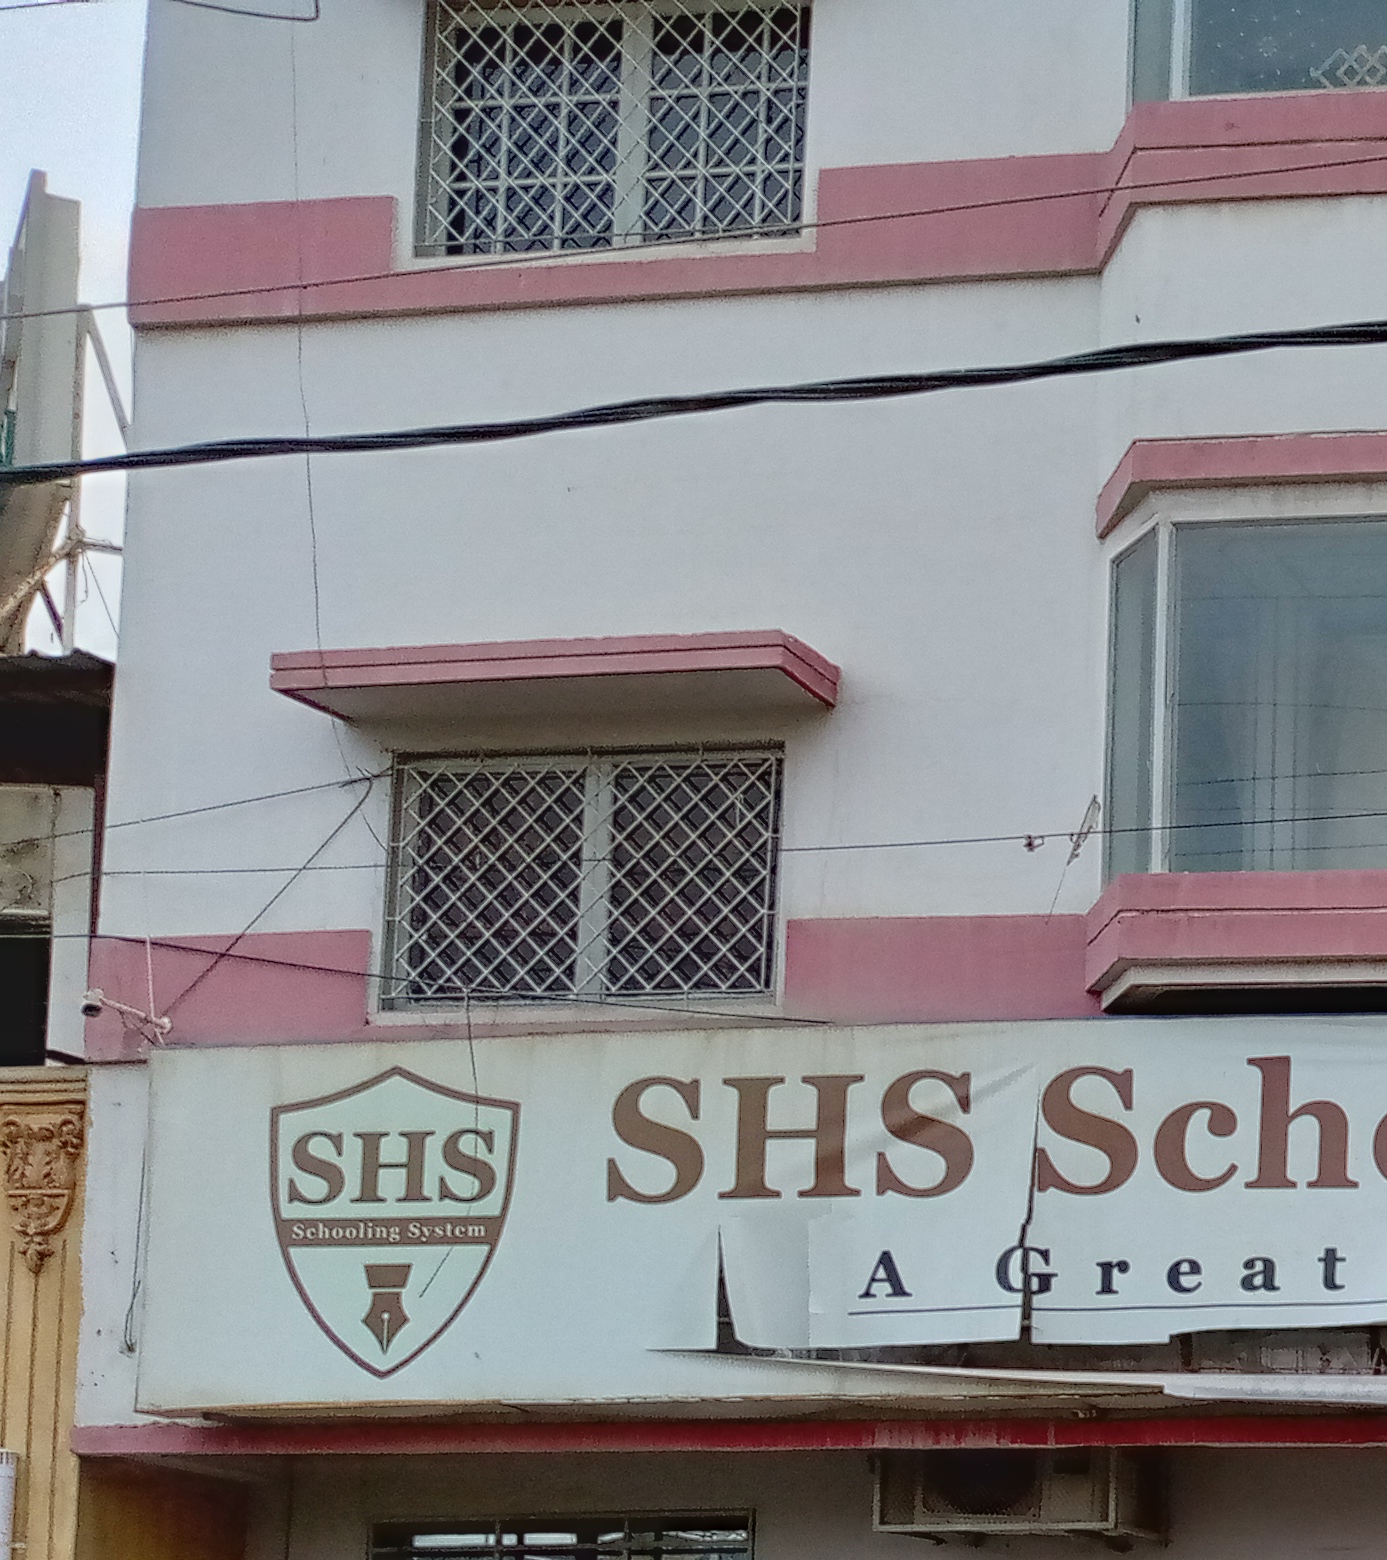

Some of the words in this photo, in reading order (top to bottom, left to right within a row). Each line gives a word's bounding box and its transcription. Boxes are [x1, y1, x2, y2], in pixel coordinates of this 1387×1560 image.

[287, 1128, 497, 1205] SHS
[606, 1069, 975, 1205] SHS
[291, 1221, 400, 1242] Schooling
[407, 1222, 486, 1242] System
[858, 1250, 913, 1299] A
[995, 1244, 1347, 1297] Great
